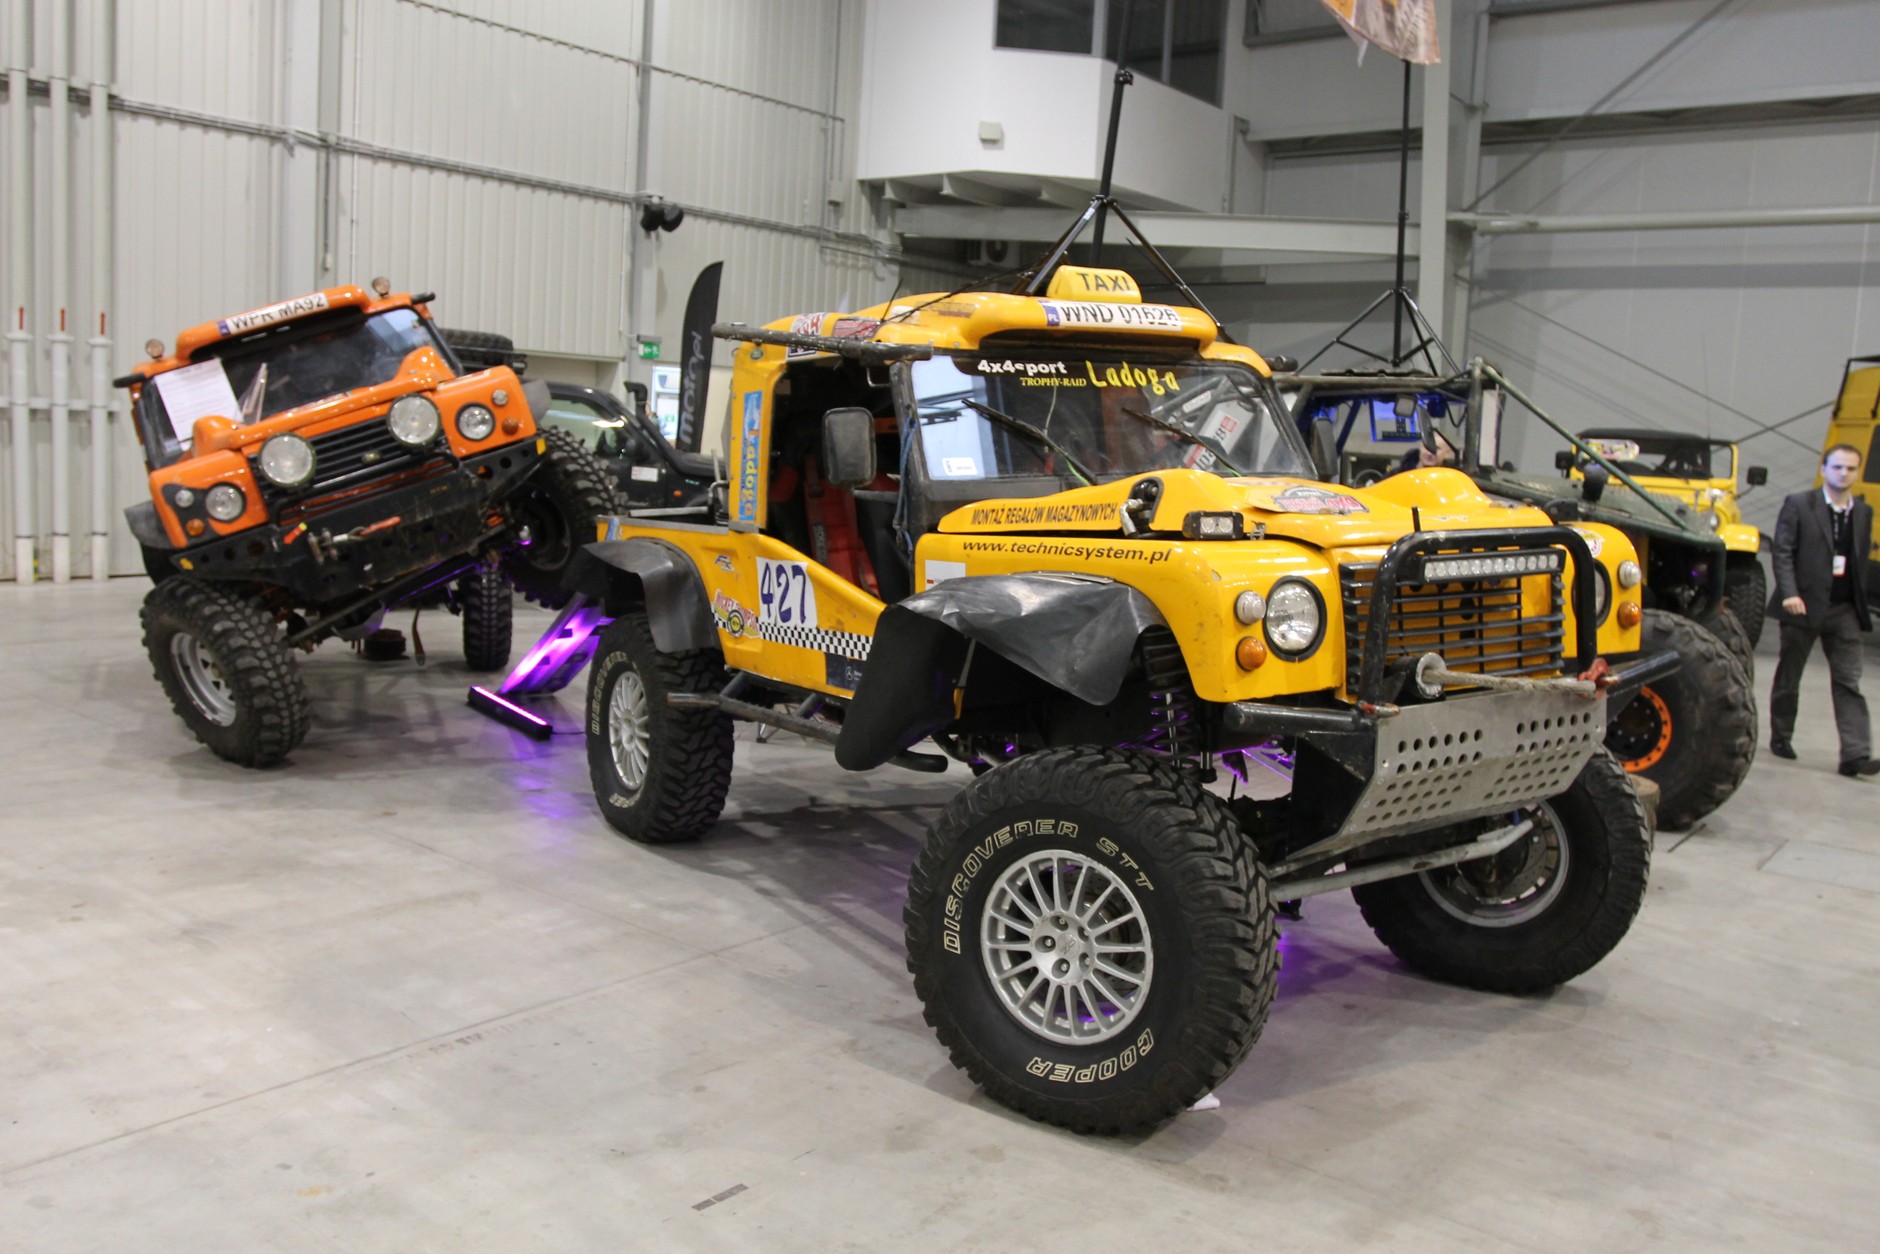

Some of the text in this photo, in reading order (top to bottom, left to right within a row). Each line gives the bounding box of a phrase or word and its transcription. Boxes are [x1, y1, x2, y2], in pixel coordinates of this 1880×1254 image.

[1077, 272, 1131, 292] TAXI
[1060, 304, 1114, 323] WND
[1020, 377, 1087, 387] TROPHY-RAID
[1085, 360, 1180, 396] Ladoga
[971, 502, 1118, 525] MONTAŻ REGAŁÓW MAGAZYNOWYCH
[963, 541, 1172, 564] www.technicsystem.pl
[761, 562, 806, 624] 427
[943, 819, 1154, 954] DISCOVERER STT
[1026, 1028, 1154, 1083] COOPER
